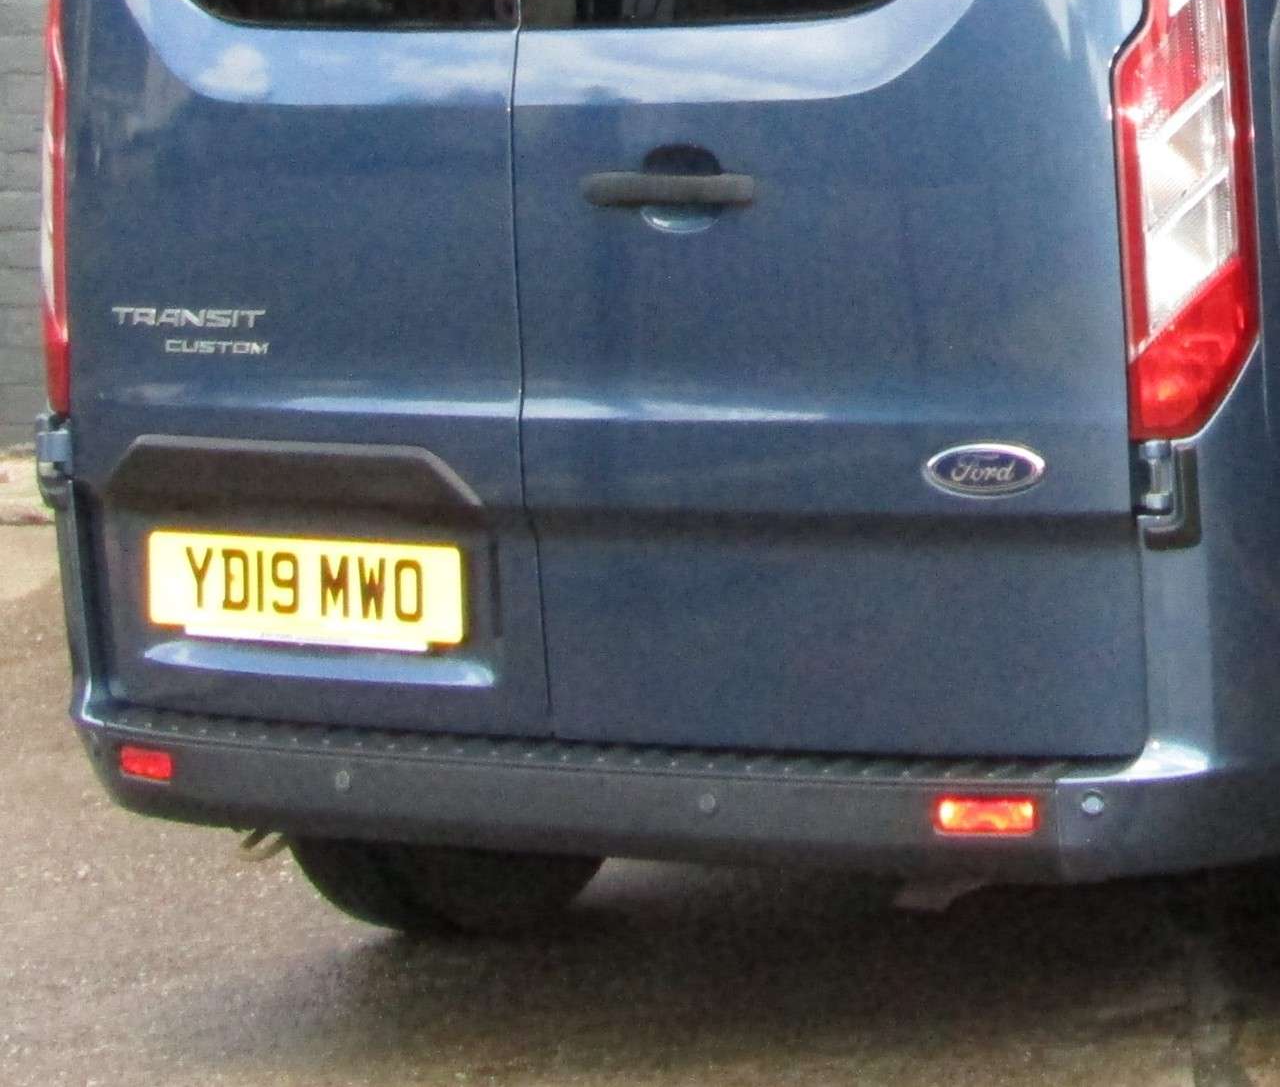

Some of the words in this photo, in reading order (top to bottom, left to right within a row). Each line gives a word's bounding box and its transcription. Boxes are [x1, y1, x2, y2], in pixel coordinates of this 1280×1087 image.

[112, 306, 266, 328] TRANSIT
[165, 339, 270, 355] CUSTOM
[951, 453, 1016, 482] Ford
[186, 546, 299, 614] YD19
[319, 554, 423, 623] MWO
